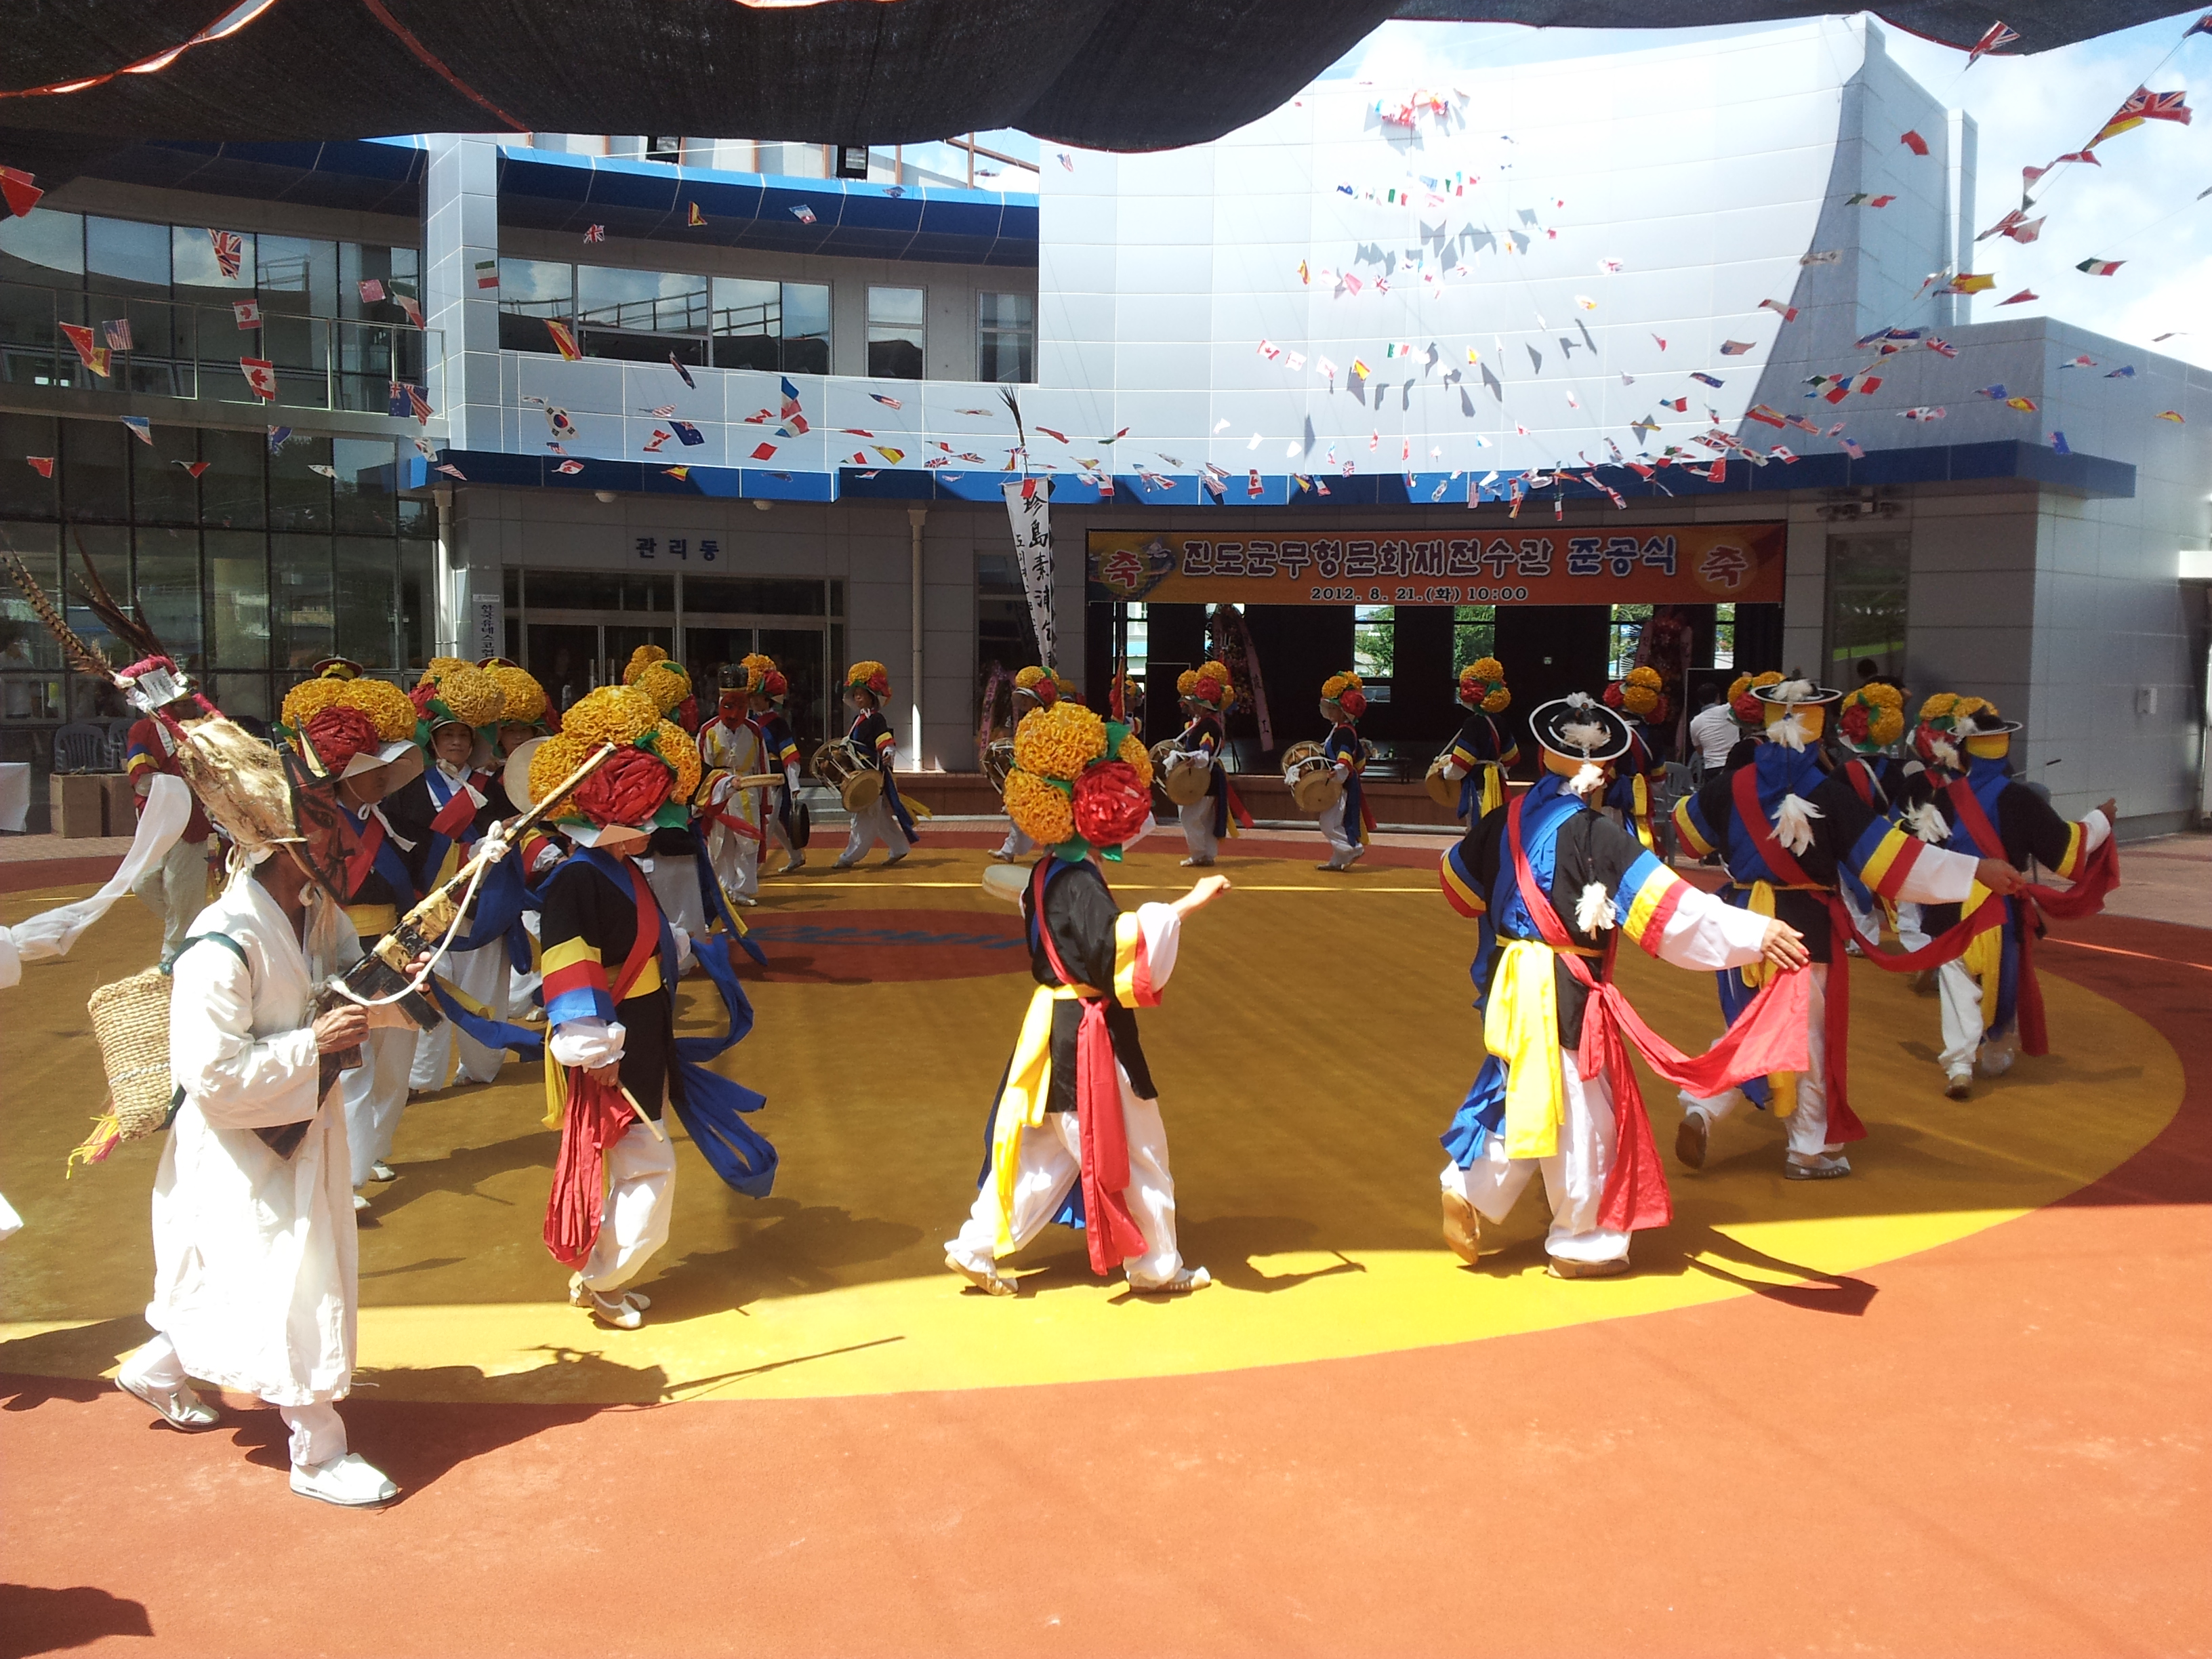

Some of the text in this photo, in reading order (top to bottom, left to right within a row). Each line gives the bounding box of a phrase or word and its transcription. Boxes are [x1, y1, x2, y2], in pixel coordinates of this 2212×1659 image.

[636, 537, 720, 561] 관리동
[1103, 549, 1143, 588] 축
[1183, 535, 1676, 579] 진도군무형문화재전수관 준공식
[1699, 544, 1748, 588] 축
[1310, 586, 1361, 601] 2012.
[1368, 586, 1389, 601] 8.
[1467, 586, 1528, 601] 10:00
